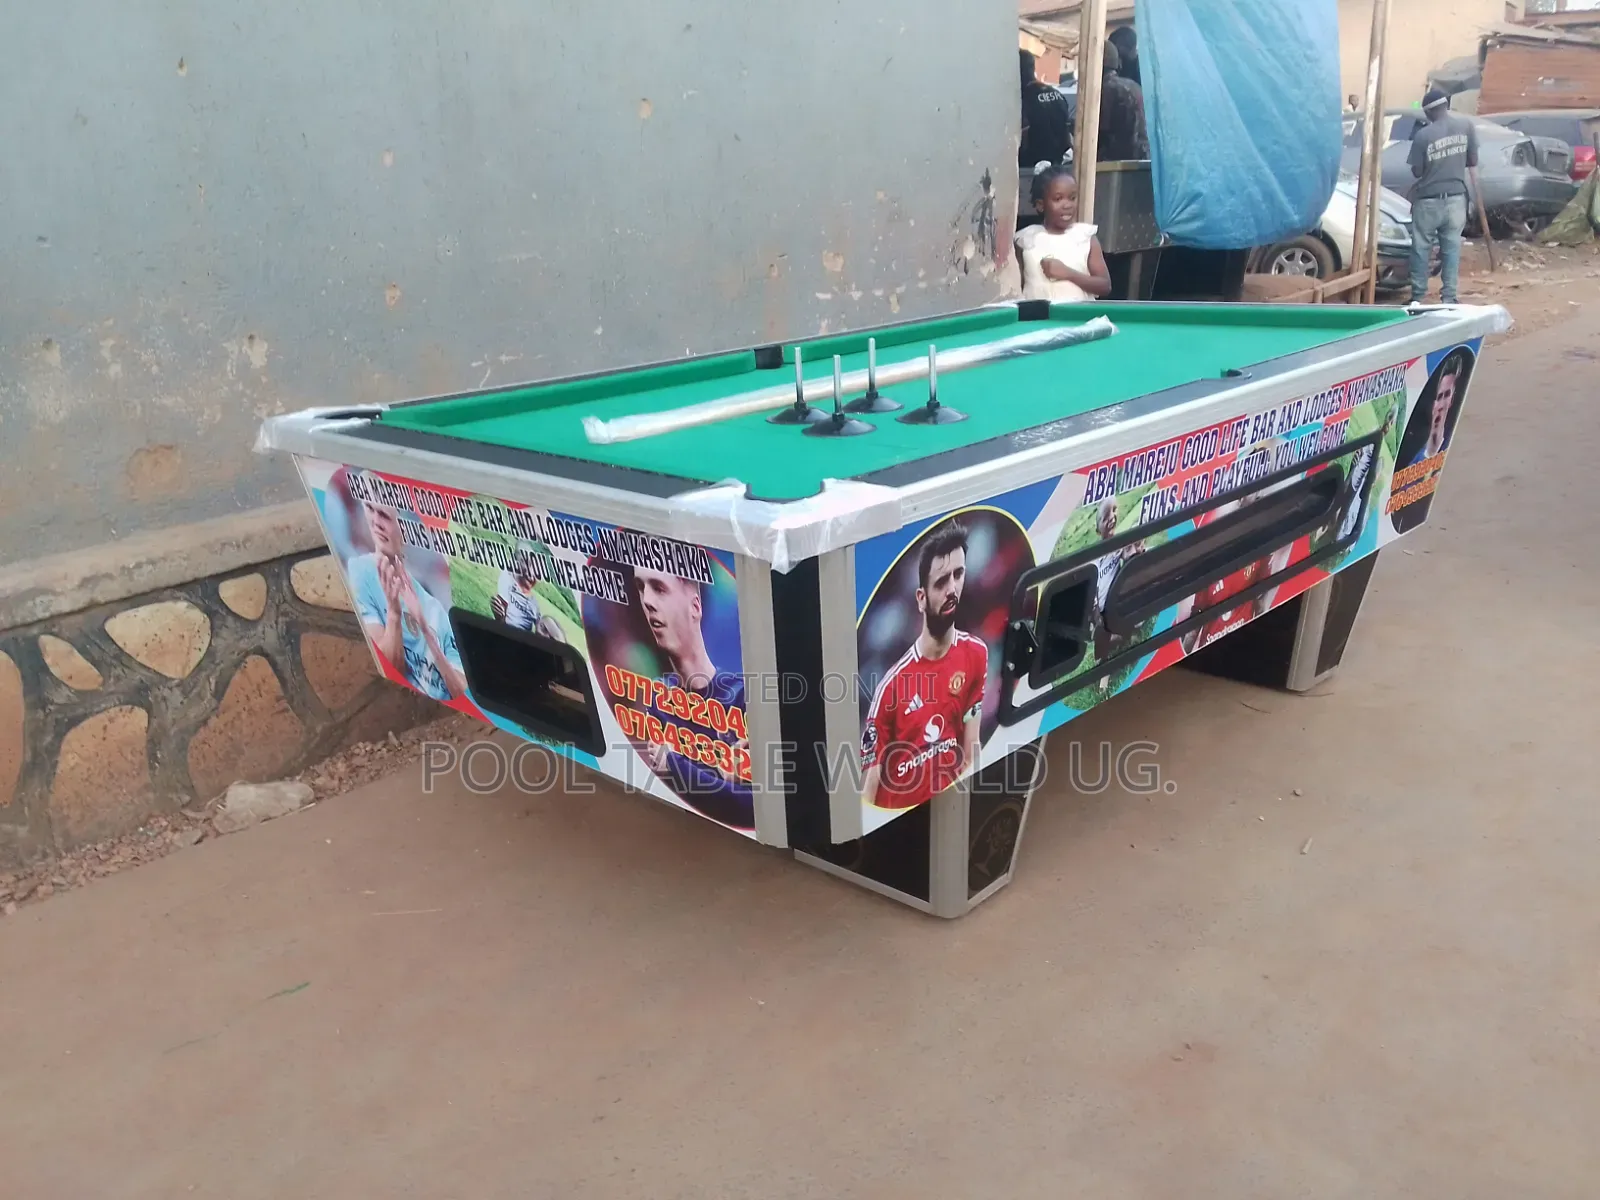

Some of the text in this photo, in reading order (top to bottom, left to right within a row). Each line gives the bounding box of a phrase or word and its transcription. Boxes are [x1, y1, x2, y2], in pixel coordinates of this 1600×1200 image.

[1082, 462, 1118, 507] ABA
[1118, 440, 1182, 494] MAREJU
[1181, 428, 1219, 471] GOOD
[1219, 418, 1250, 456] LIFE
[1250, 407, 1277, 444] BAR
[1276, 399, 1303, 435] AND
[1302, 383, 1346, 425] LODGES
[1139, 483, 1179, 525] FUNS
[1181, 472, 1210, 508] AND
[1274, 438, 1298, 472] YOU
[1298, 417, 1350, 462] WELCOME
[346, 472, 371, 501] ABA
[413, 486, 448, 519] GOOD
[447, 493, 478, 527] LIFE
[475, 501, 508, 535] BAR
[507, 507, 537, 541] AND
[537, 514, 597, 557] LODGES
[597, 526, 714, 584] NYAKASHAKA
[397, 518, 629, 605] FUNS AND PLAYFULL YOU WELCOME
[605, 664, 748, 739] 07729204
